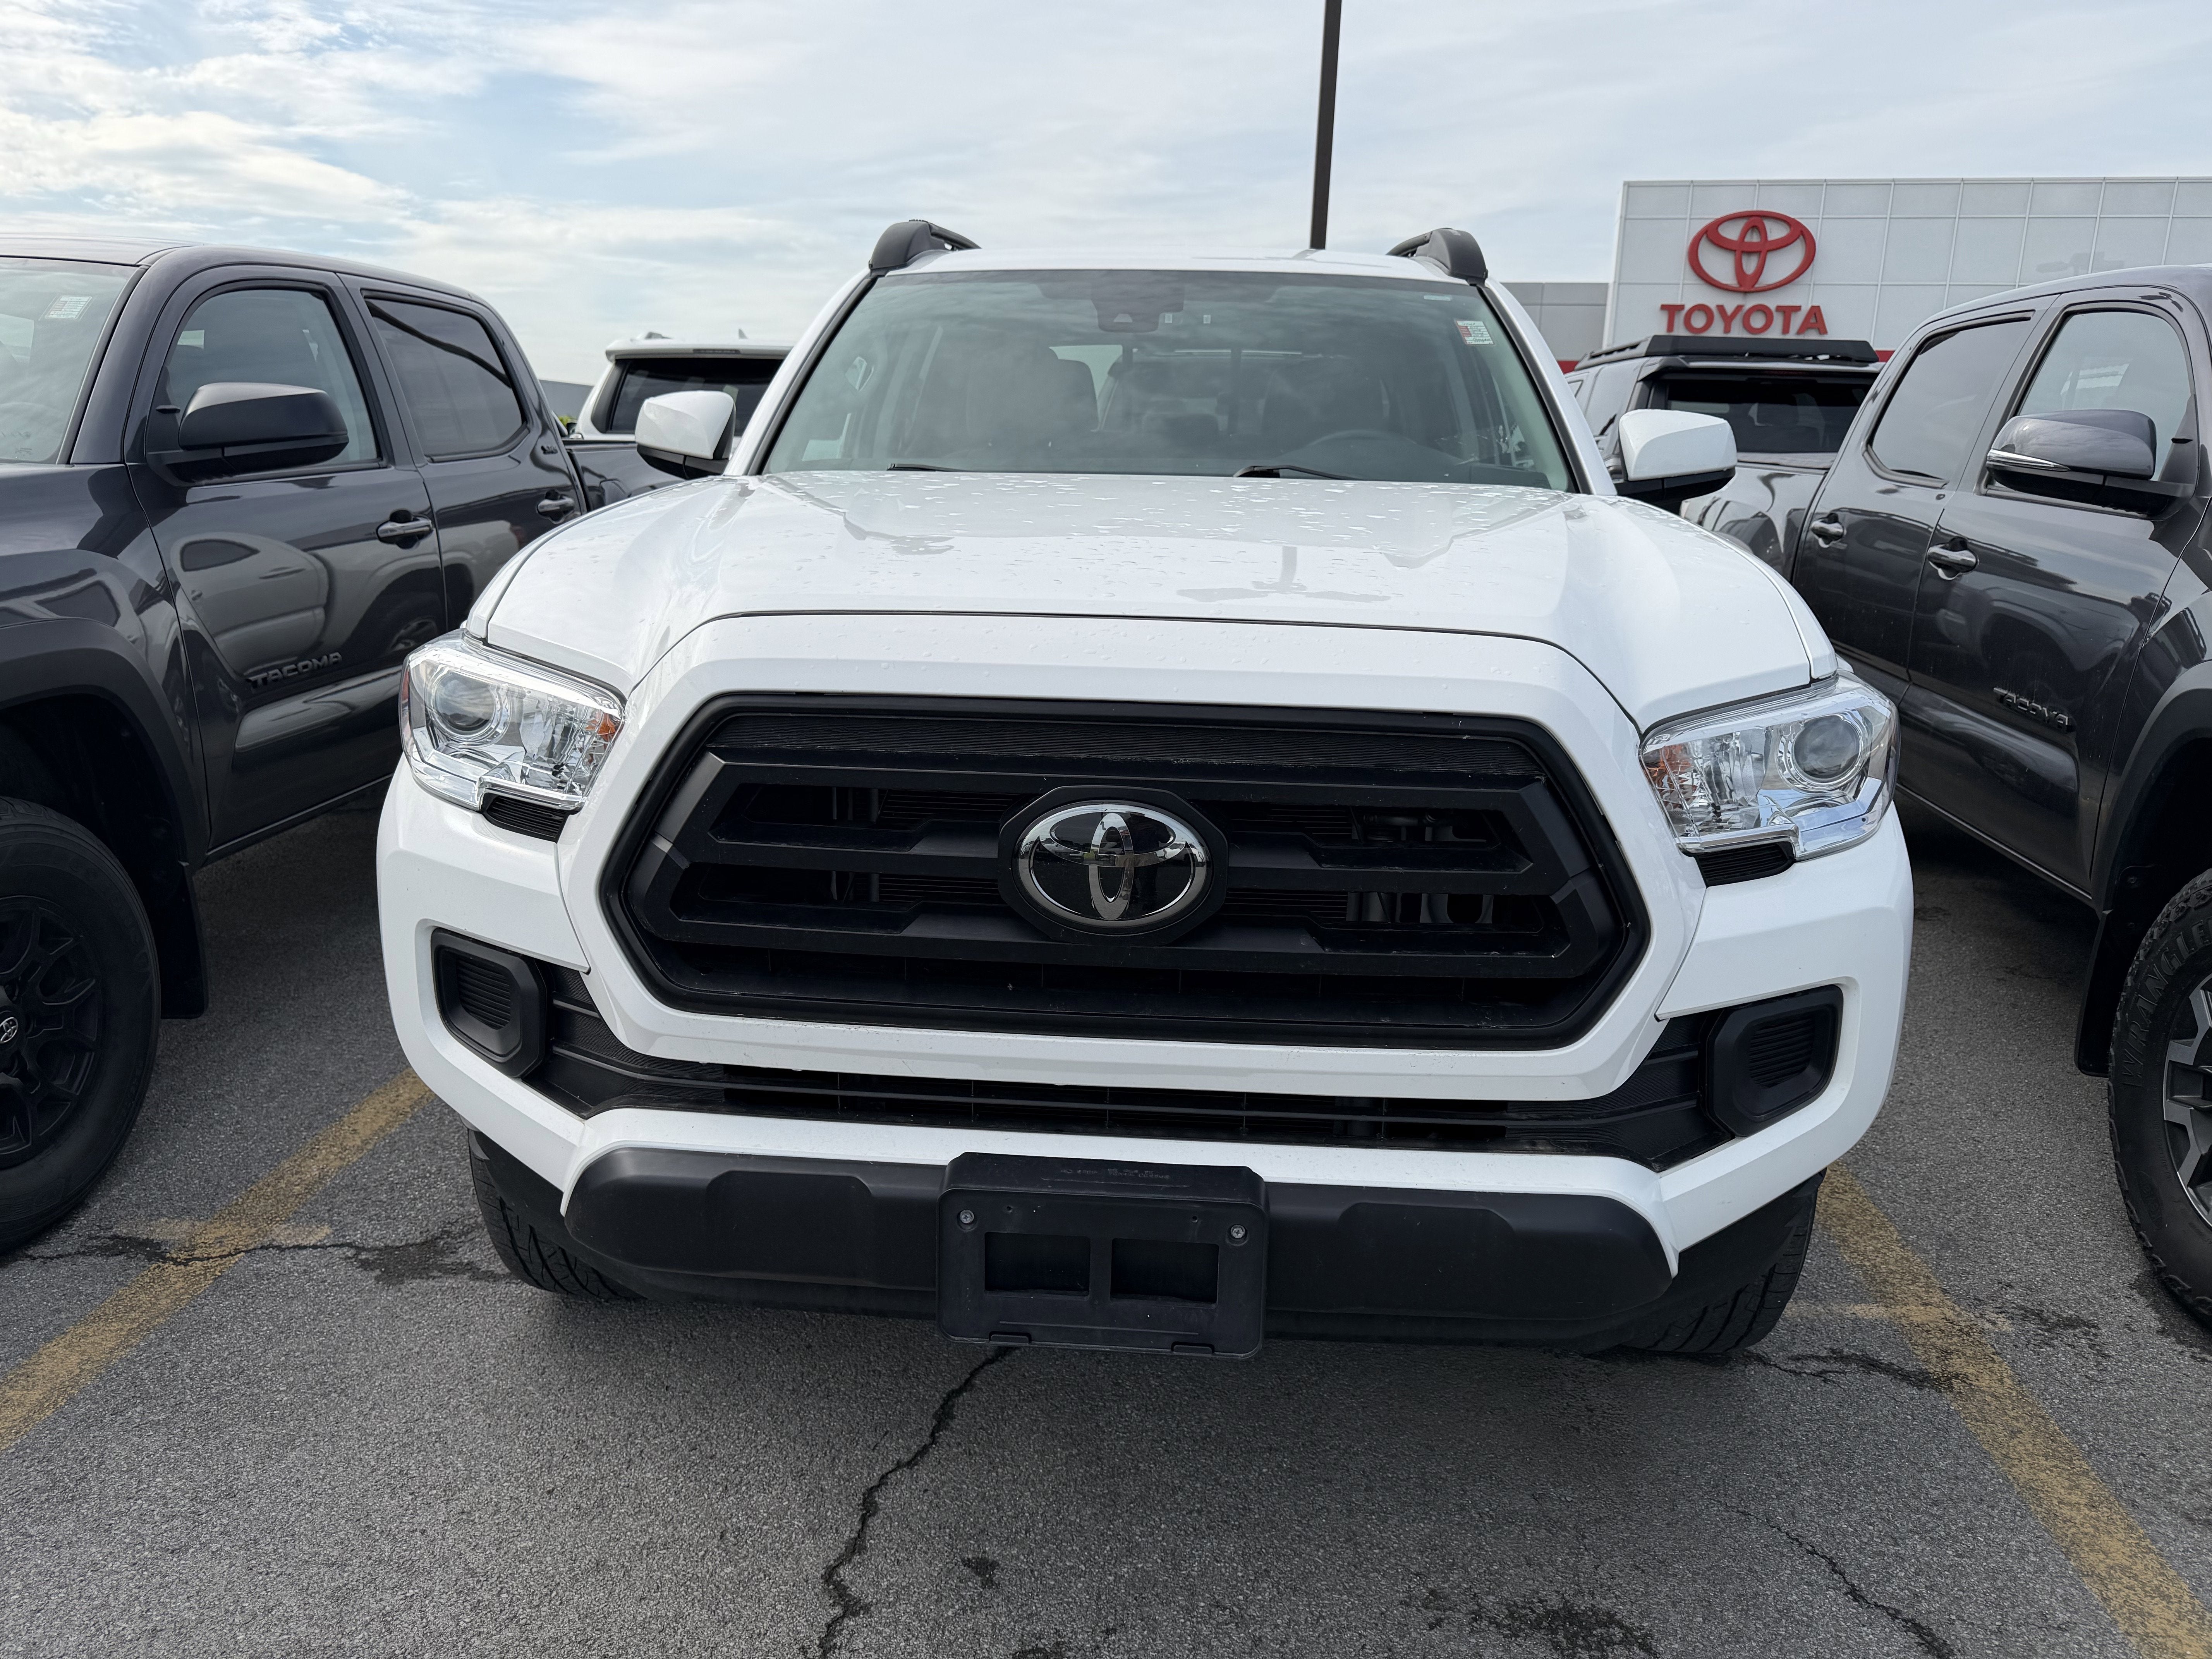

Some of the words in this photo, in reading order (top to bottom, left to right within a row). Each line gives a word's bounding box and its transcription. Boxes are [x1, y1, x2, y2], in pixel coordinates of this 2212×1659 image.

[1660, 303, 1828, 335] TOYOTA
[247, 651, 343, 687] TACOMA
[2122, 916, 2212, 1086] WRANGLE
